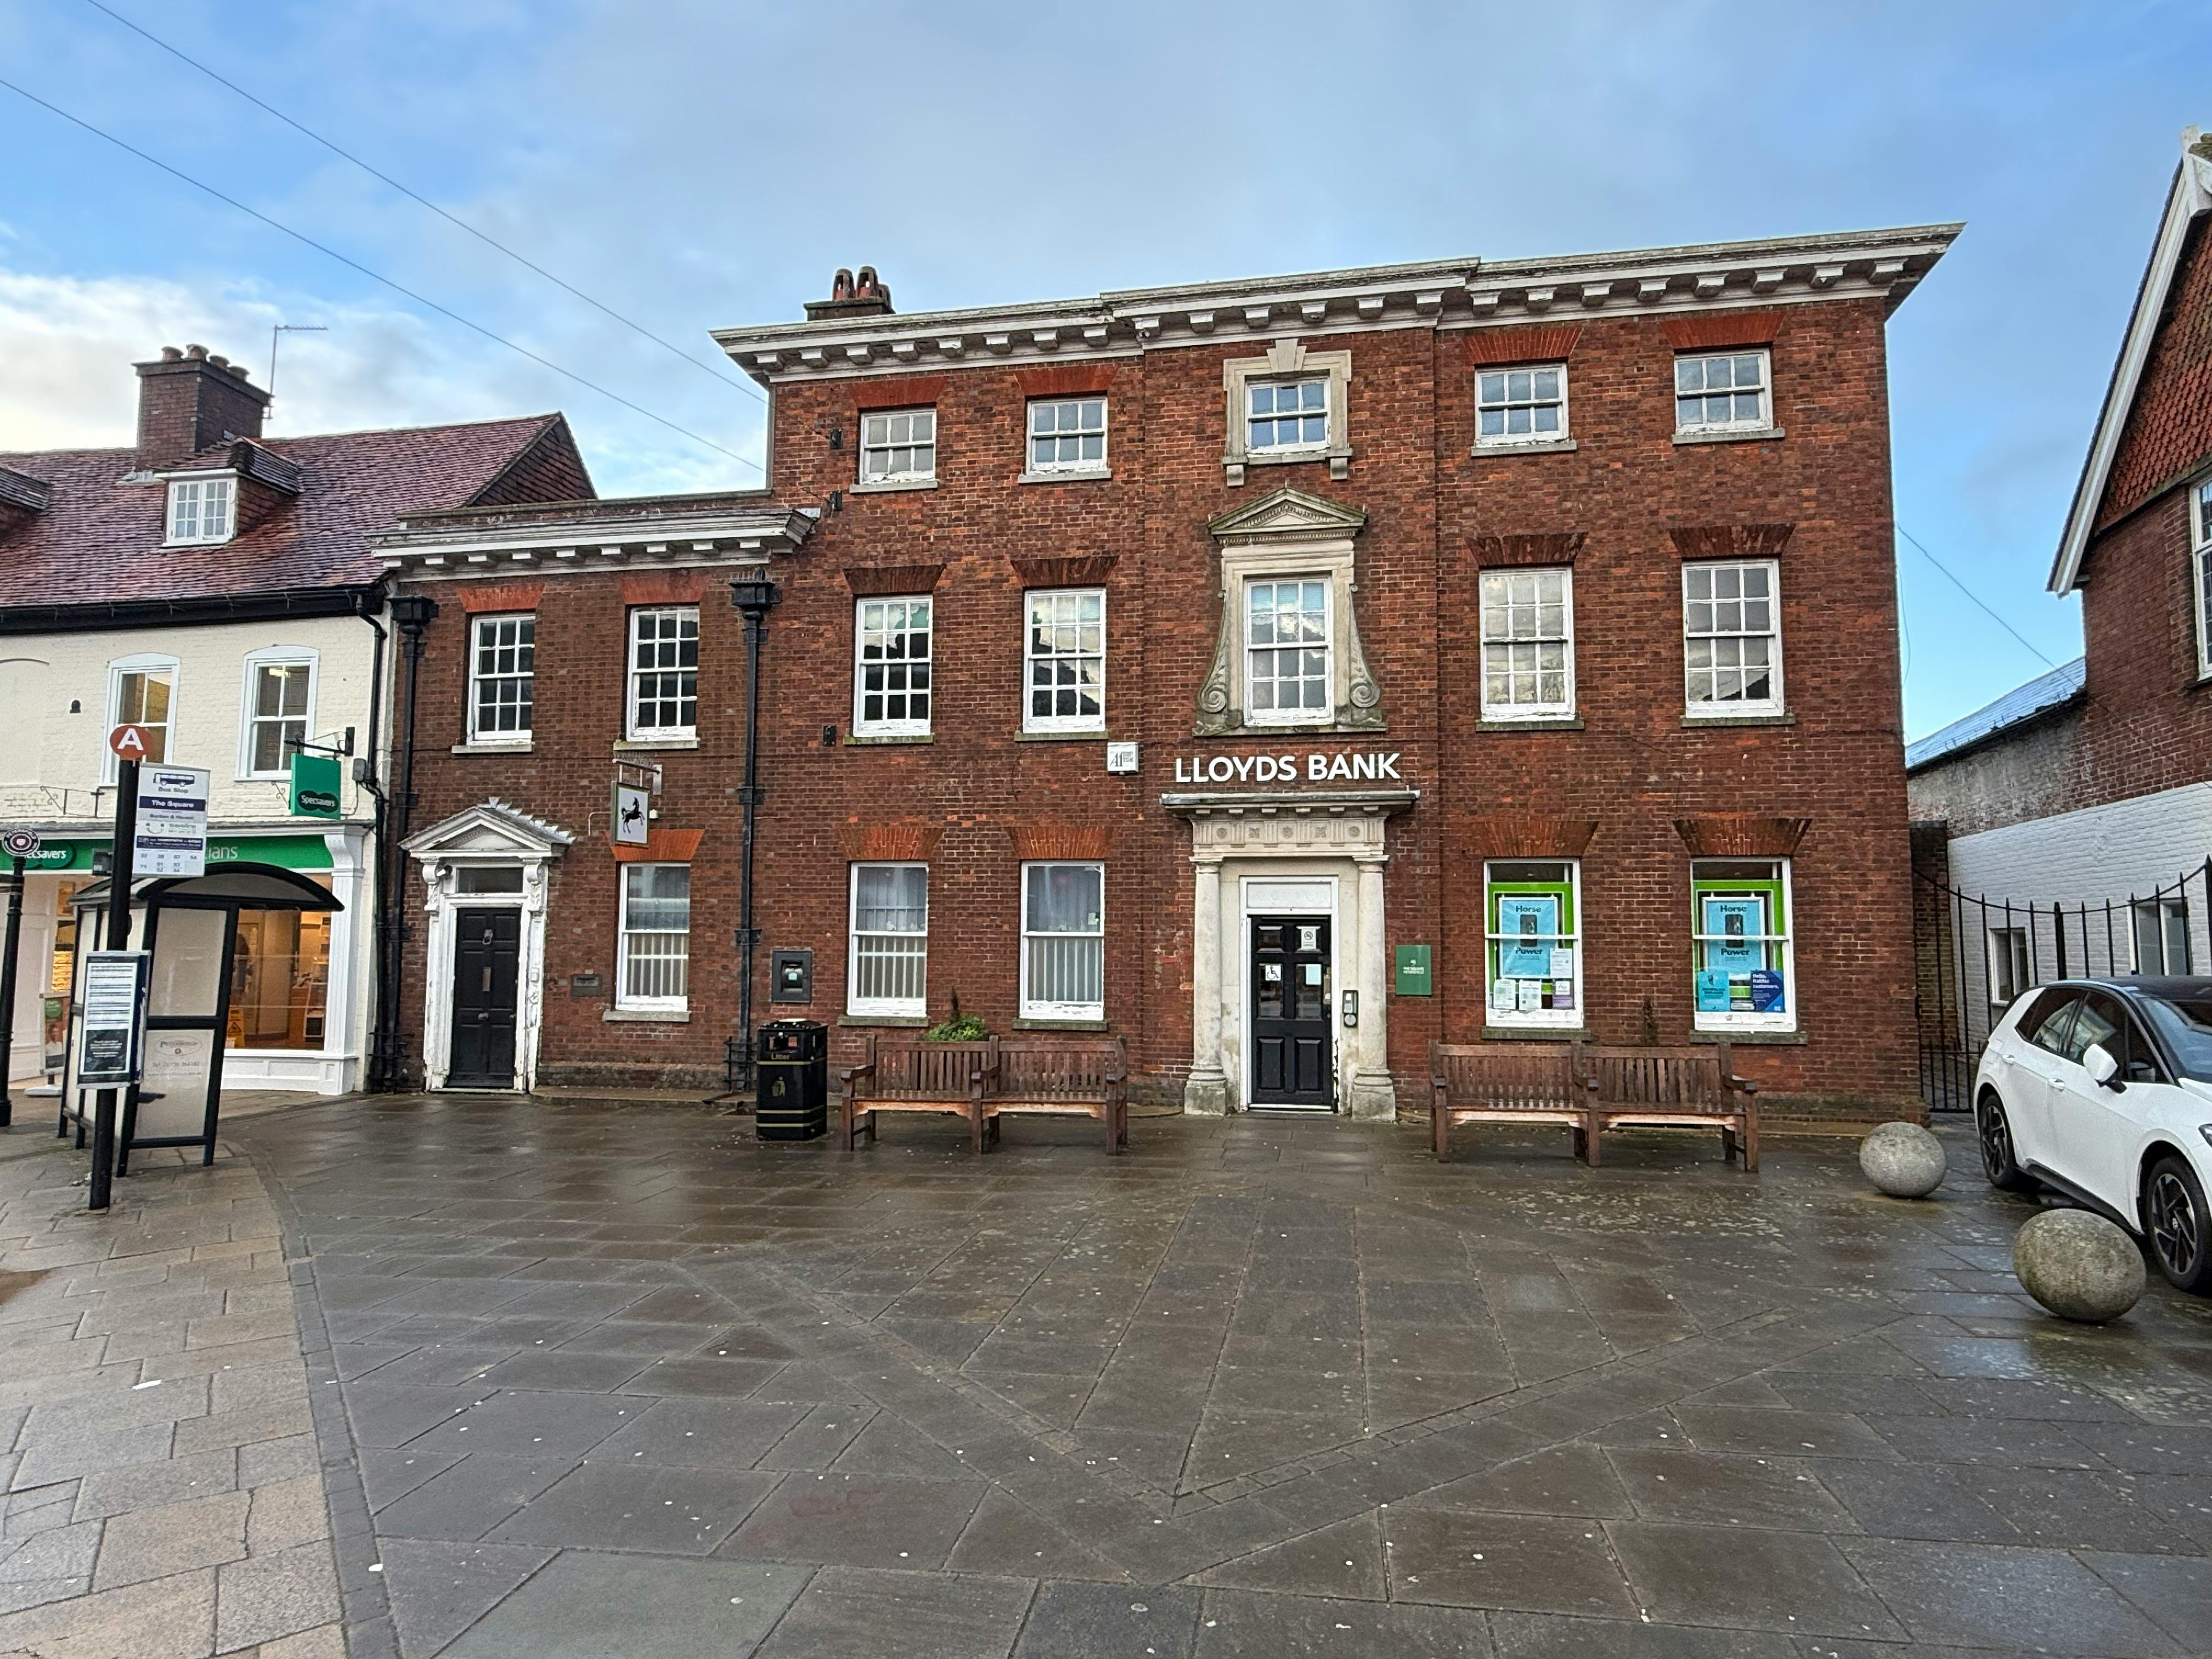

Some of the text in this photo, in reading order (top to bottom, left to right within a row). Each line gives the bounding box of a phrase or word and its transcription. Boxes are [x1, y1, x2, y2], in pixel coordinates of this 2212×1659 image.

[117, 727, 144, 751] A
[1176, 753, 1401, 782] LLOYDS BANK
[301, 794, 335, 808] Specsavers
[1720, 905, 1747, 913] Horse
